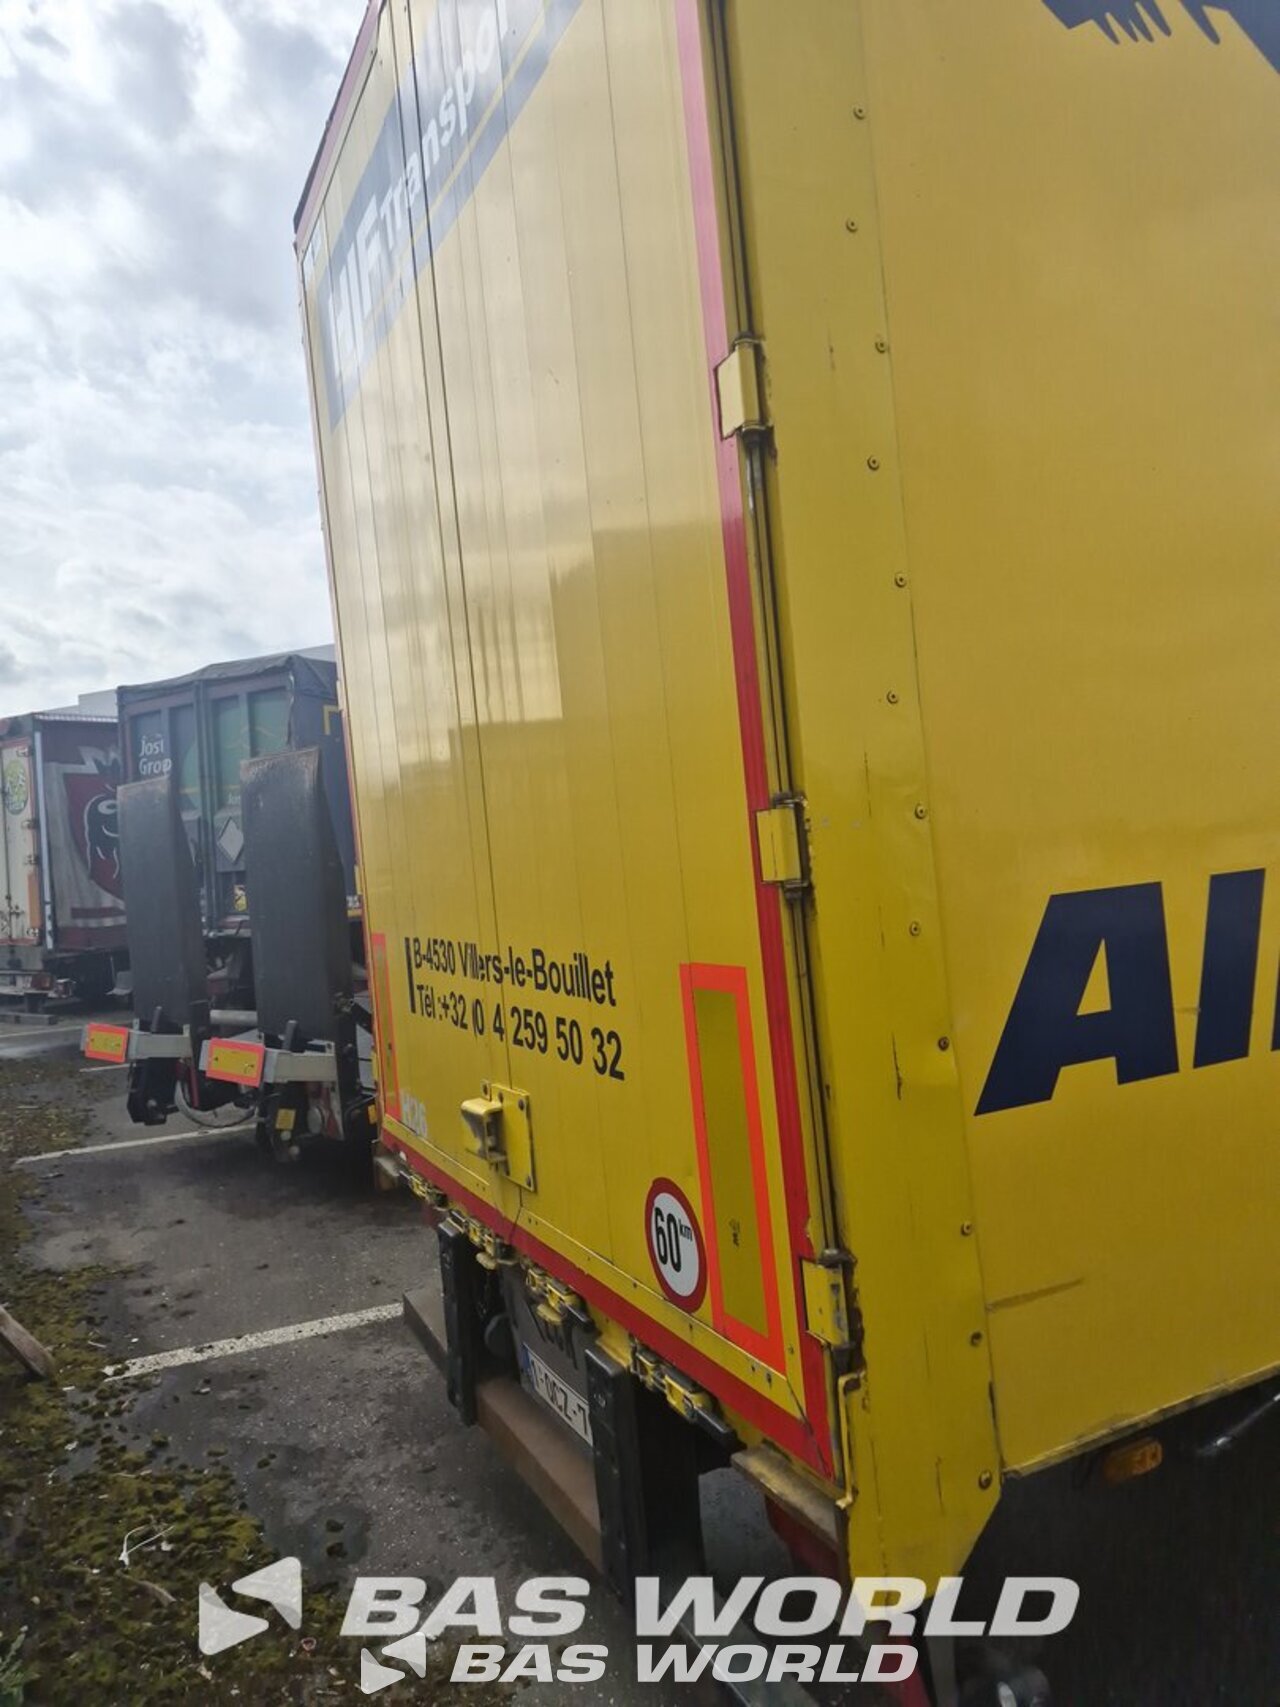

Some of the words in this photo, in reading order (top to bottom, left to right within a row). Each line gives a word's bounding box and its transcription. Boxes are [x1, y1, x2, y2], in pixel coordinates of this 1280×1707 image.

[414, 937, 456, 976] B-4530
[457, 942, 617, 1007] Villers-le-Bouillet
[974, 868, 1280, 1116] AI
[493, 1003, 505, 1041] 4
[511, 1005, 548, 1055] 259
[556, 1016, 582, 1066] 50
[591, 1027, 625, 1081] 32
[655, 1206, 682, 1273] 60
[678, 1218, 693, 1242] km
